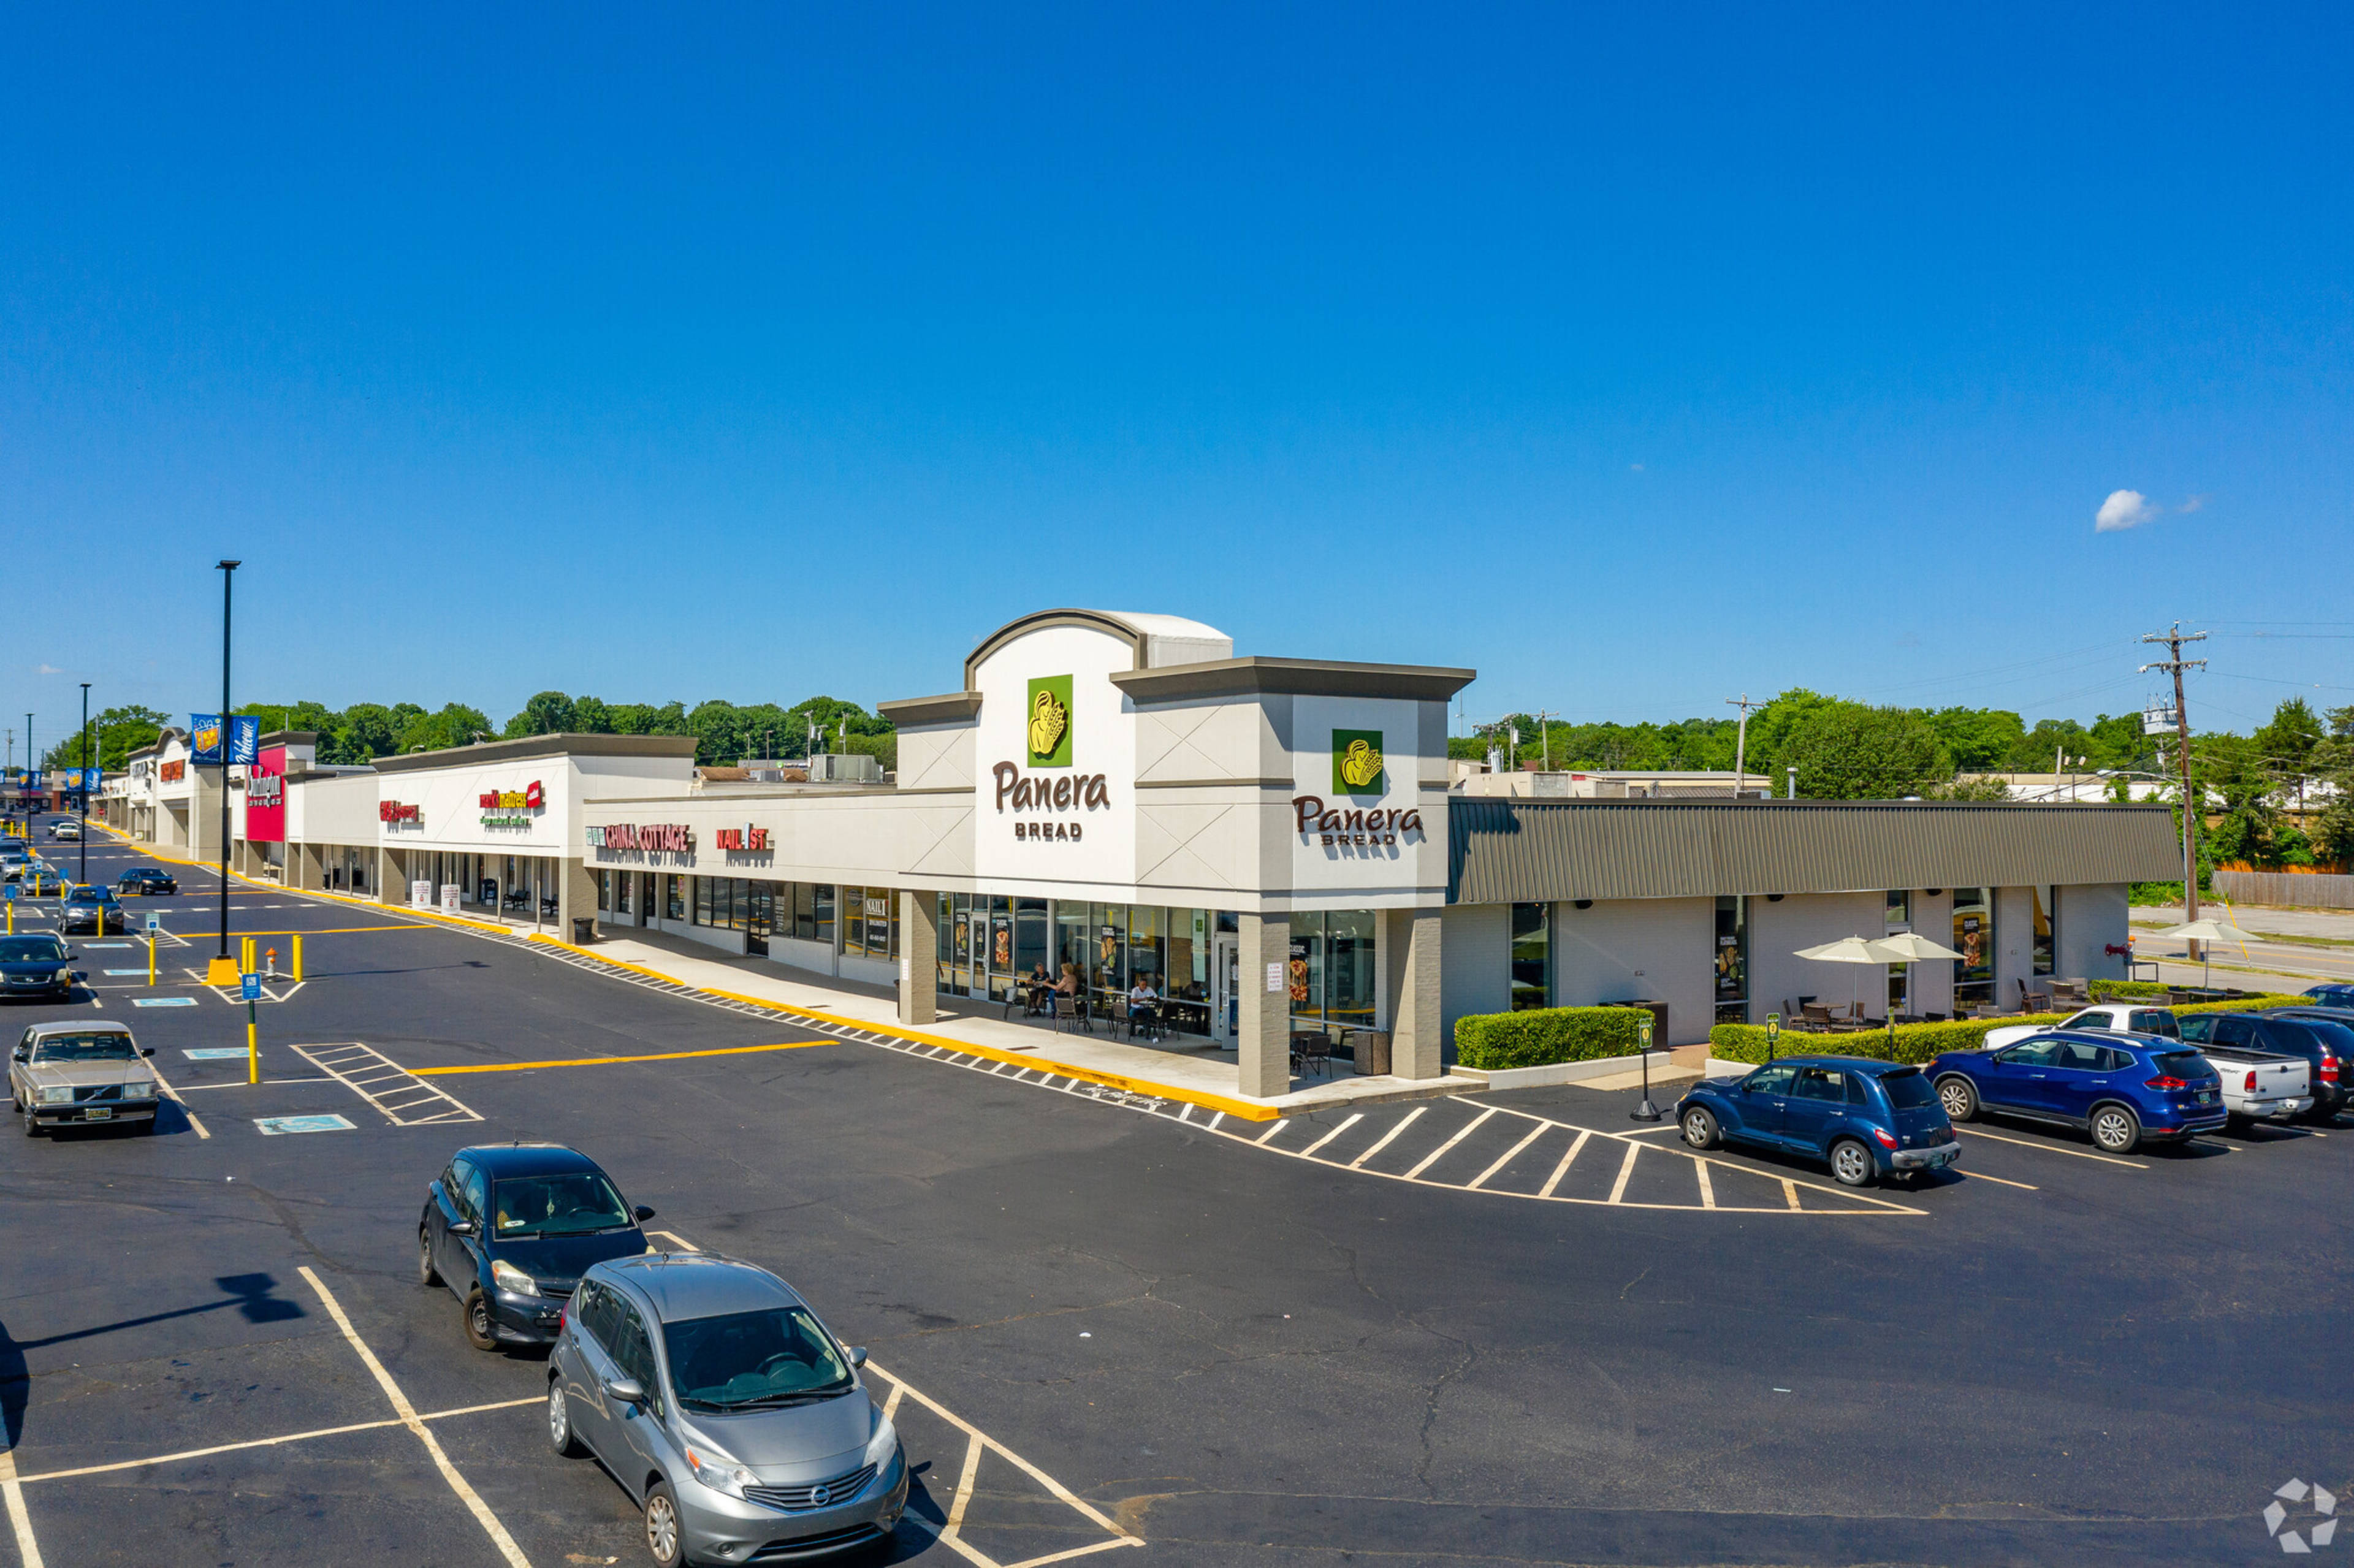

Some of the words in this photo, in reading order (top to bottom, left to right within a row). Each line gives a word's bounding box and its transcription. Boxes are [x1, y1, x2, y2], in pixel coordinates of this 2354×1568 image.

[992, 761, 1110, 810] Panera
[1292, 795, 1423, 833] Panera
[606, 824, 636, 849] CHINA
[638, 824, 688, 851] COTTAGE
[717, 829, 742, 850] NAIL
[1015, 823, 1082, 837] BREAD
[1322, 834, 1395, 847] BREAD
